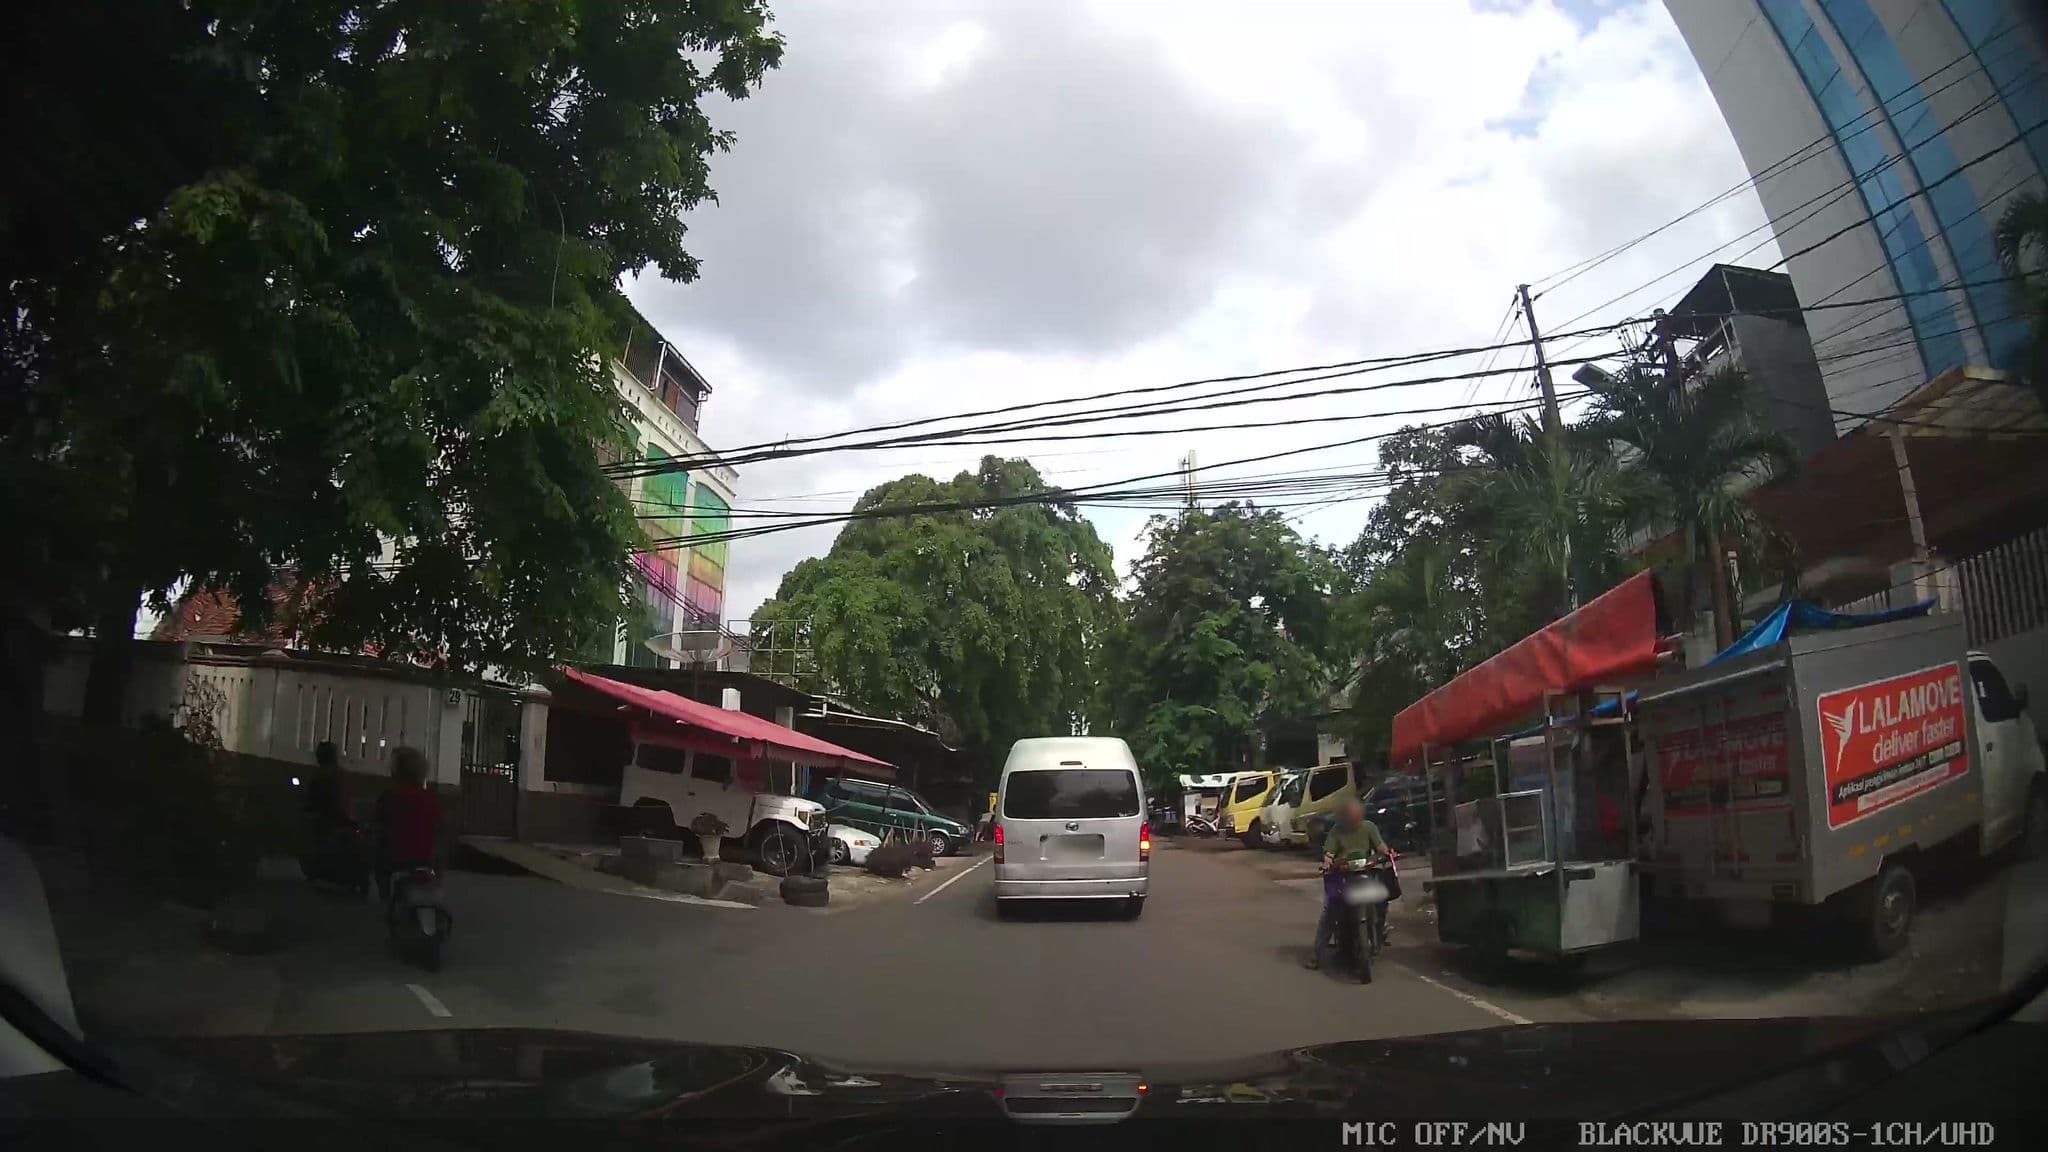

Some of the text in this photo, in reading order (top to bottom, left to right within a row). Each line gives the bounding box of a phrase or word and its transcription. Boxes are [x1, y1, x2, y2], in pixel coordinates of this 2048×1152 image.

[449, 690, 461, 703] 29
[1858, 675, 1961, 735] LALAMOVE
[1872, 729, 1919, 765] deliver
[1922, 715, 1956, 747] faster
